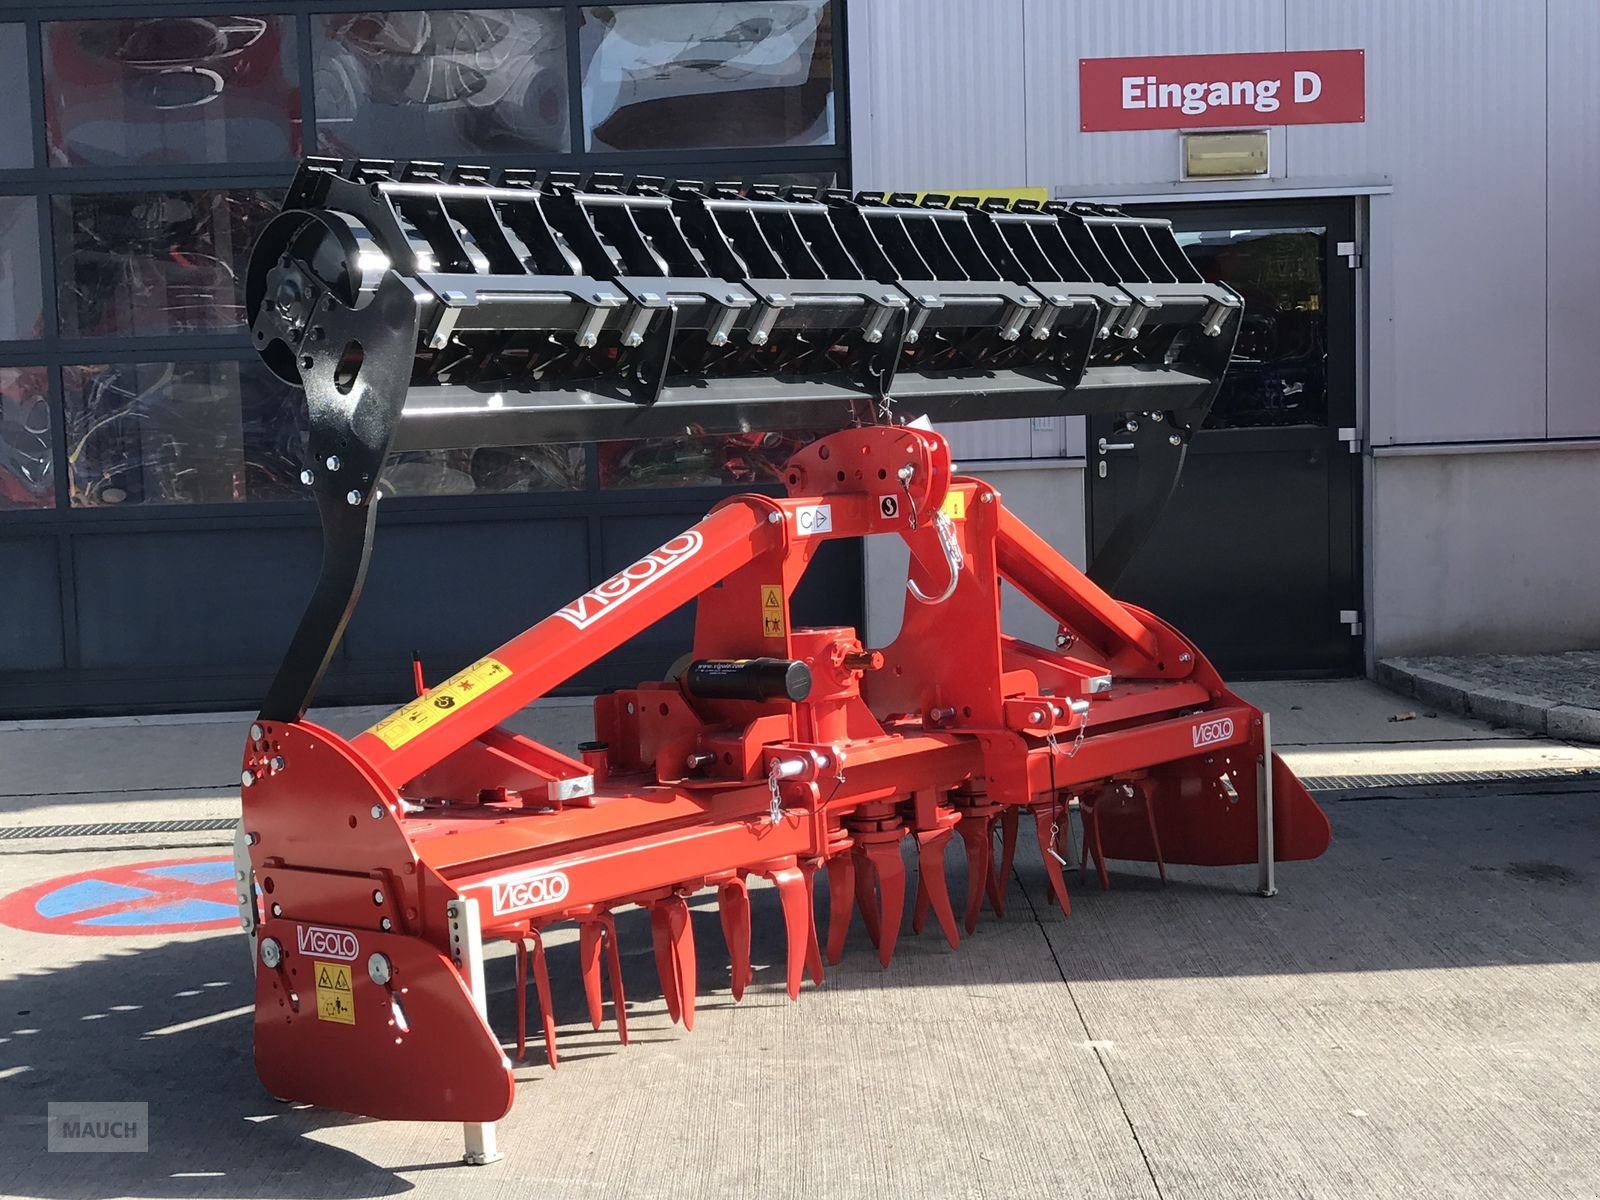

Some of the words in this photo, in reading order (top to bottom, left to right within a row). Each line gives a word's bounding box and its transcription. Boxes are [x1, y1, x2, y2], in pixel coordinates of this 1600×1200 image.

[1122, 76, 1280, 115] Eingang
[1294, 70, 1322, 103] D
[556, 532, 700, 626] VIGOLO
[1193, 718, 1232, 746] VIGOLO
[493, 874, 568, 914] VIGOLO
[298, 926, 358, 959] VIGOLO
